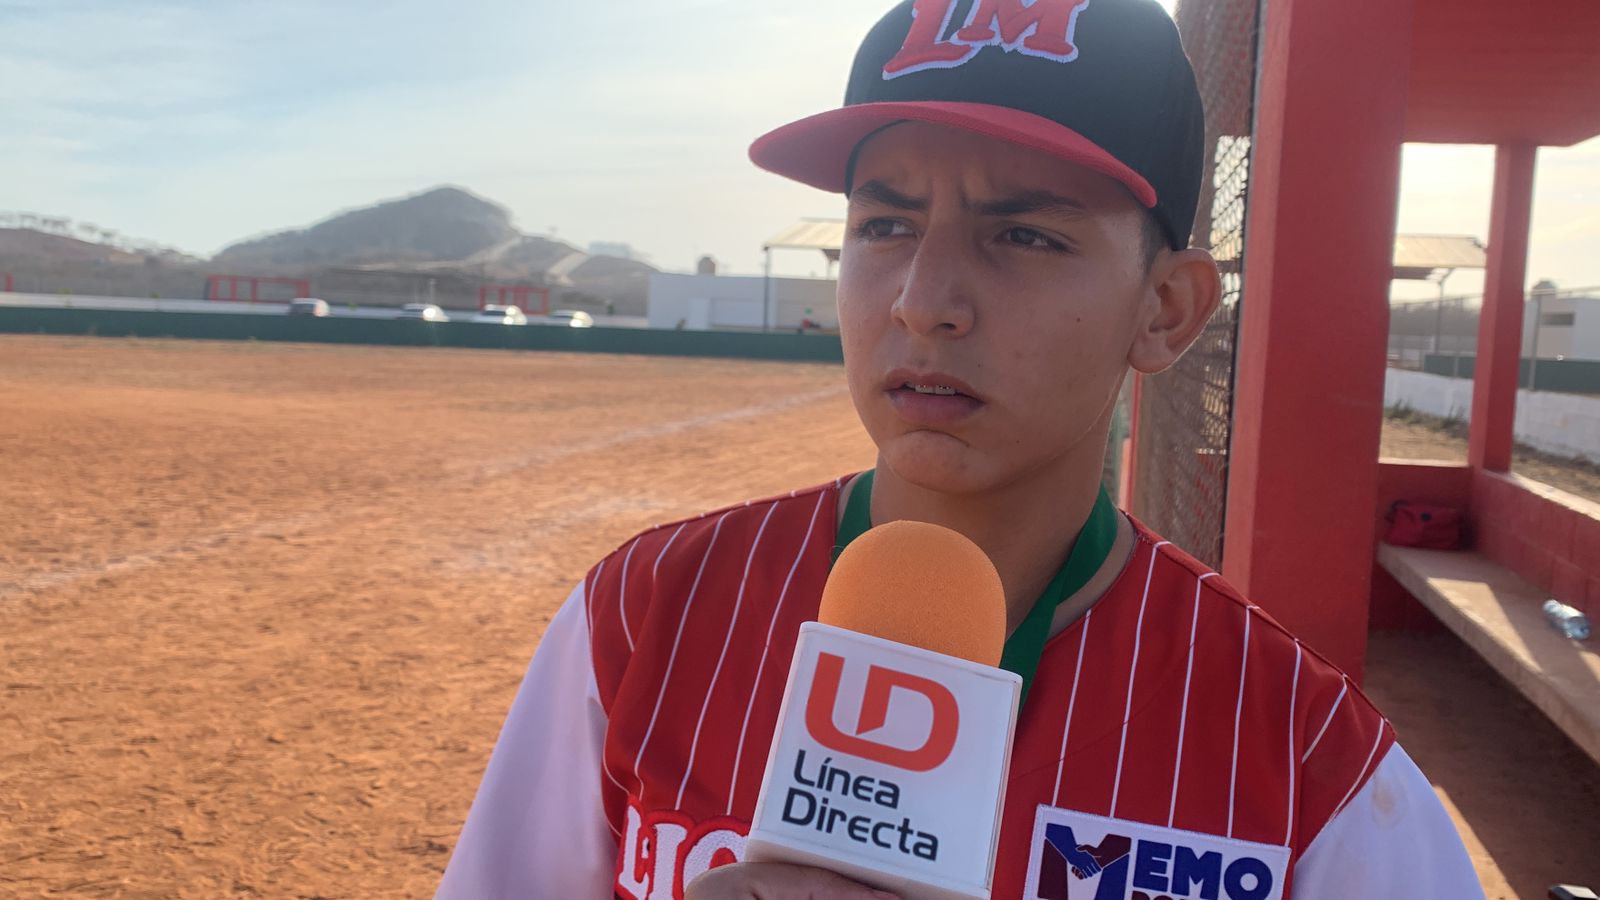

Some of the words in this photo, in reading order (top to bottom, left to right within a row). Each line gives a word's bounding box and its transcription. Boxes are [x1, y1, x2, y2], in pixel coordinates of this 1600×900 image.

[882, 0, 1088, 79] LM
[793, 749, 900, 809] Línea
[781, 787, 939, 861] Directa
[1037, 822, 1273, 900] MEMO
